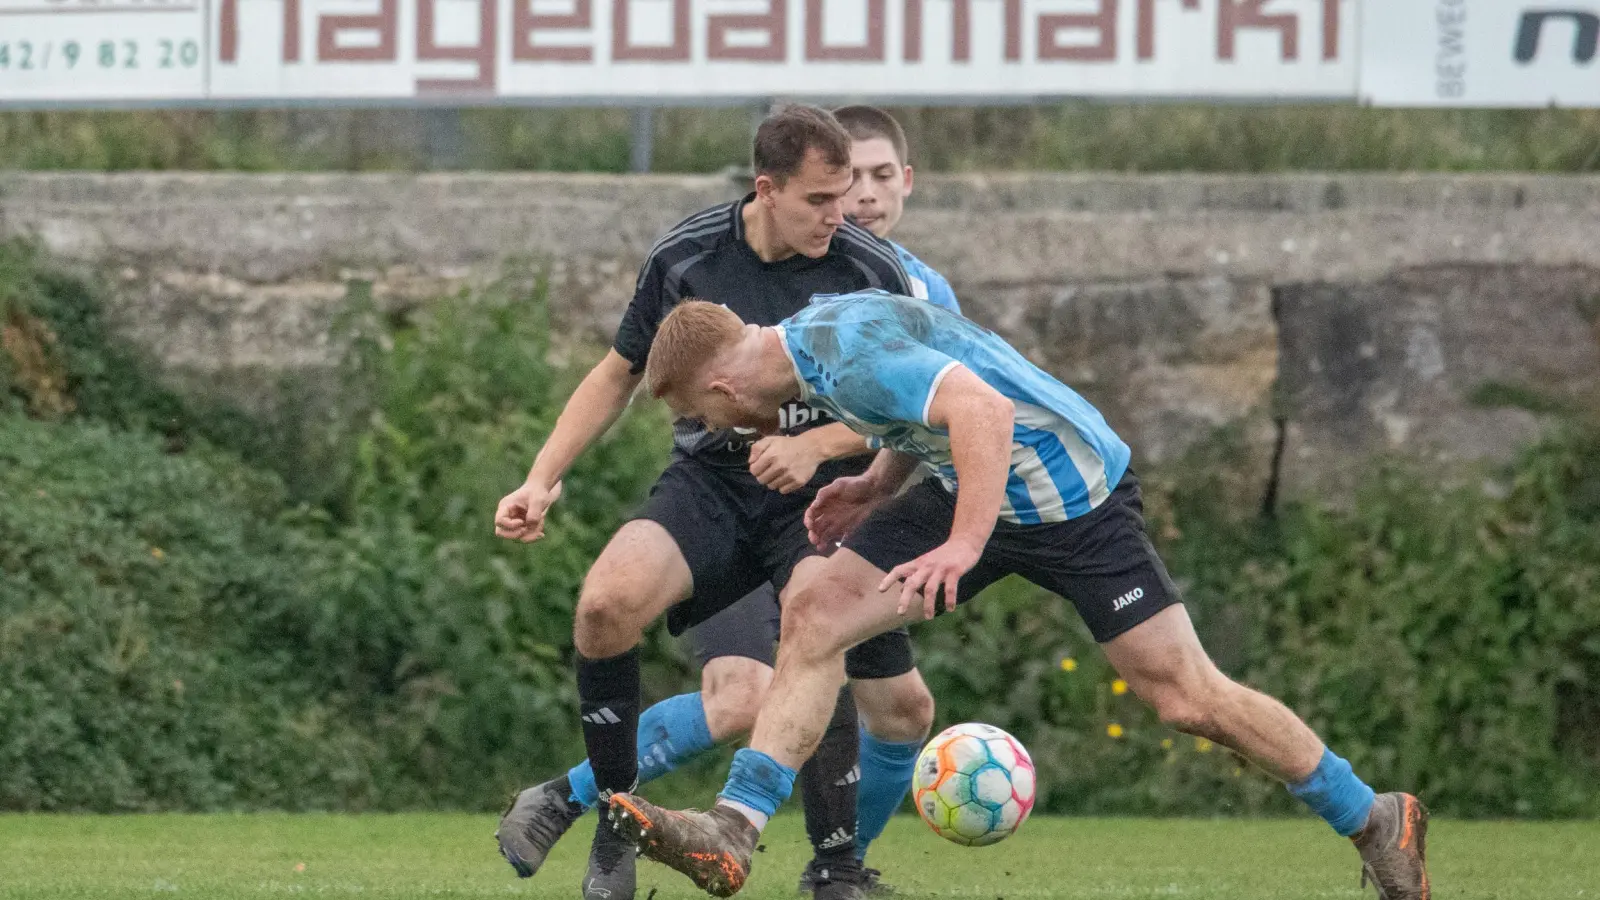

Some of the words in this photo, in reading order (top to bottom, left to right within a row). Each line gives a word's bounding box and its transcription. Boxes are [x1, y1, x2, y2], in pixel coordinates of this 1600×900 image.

[98, 39, 139, 69] 82
[157, 38, 200, 69] 20
[1112, 587, 1144, 611] JAKO
